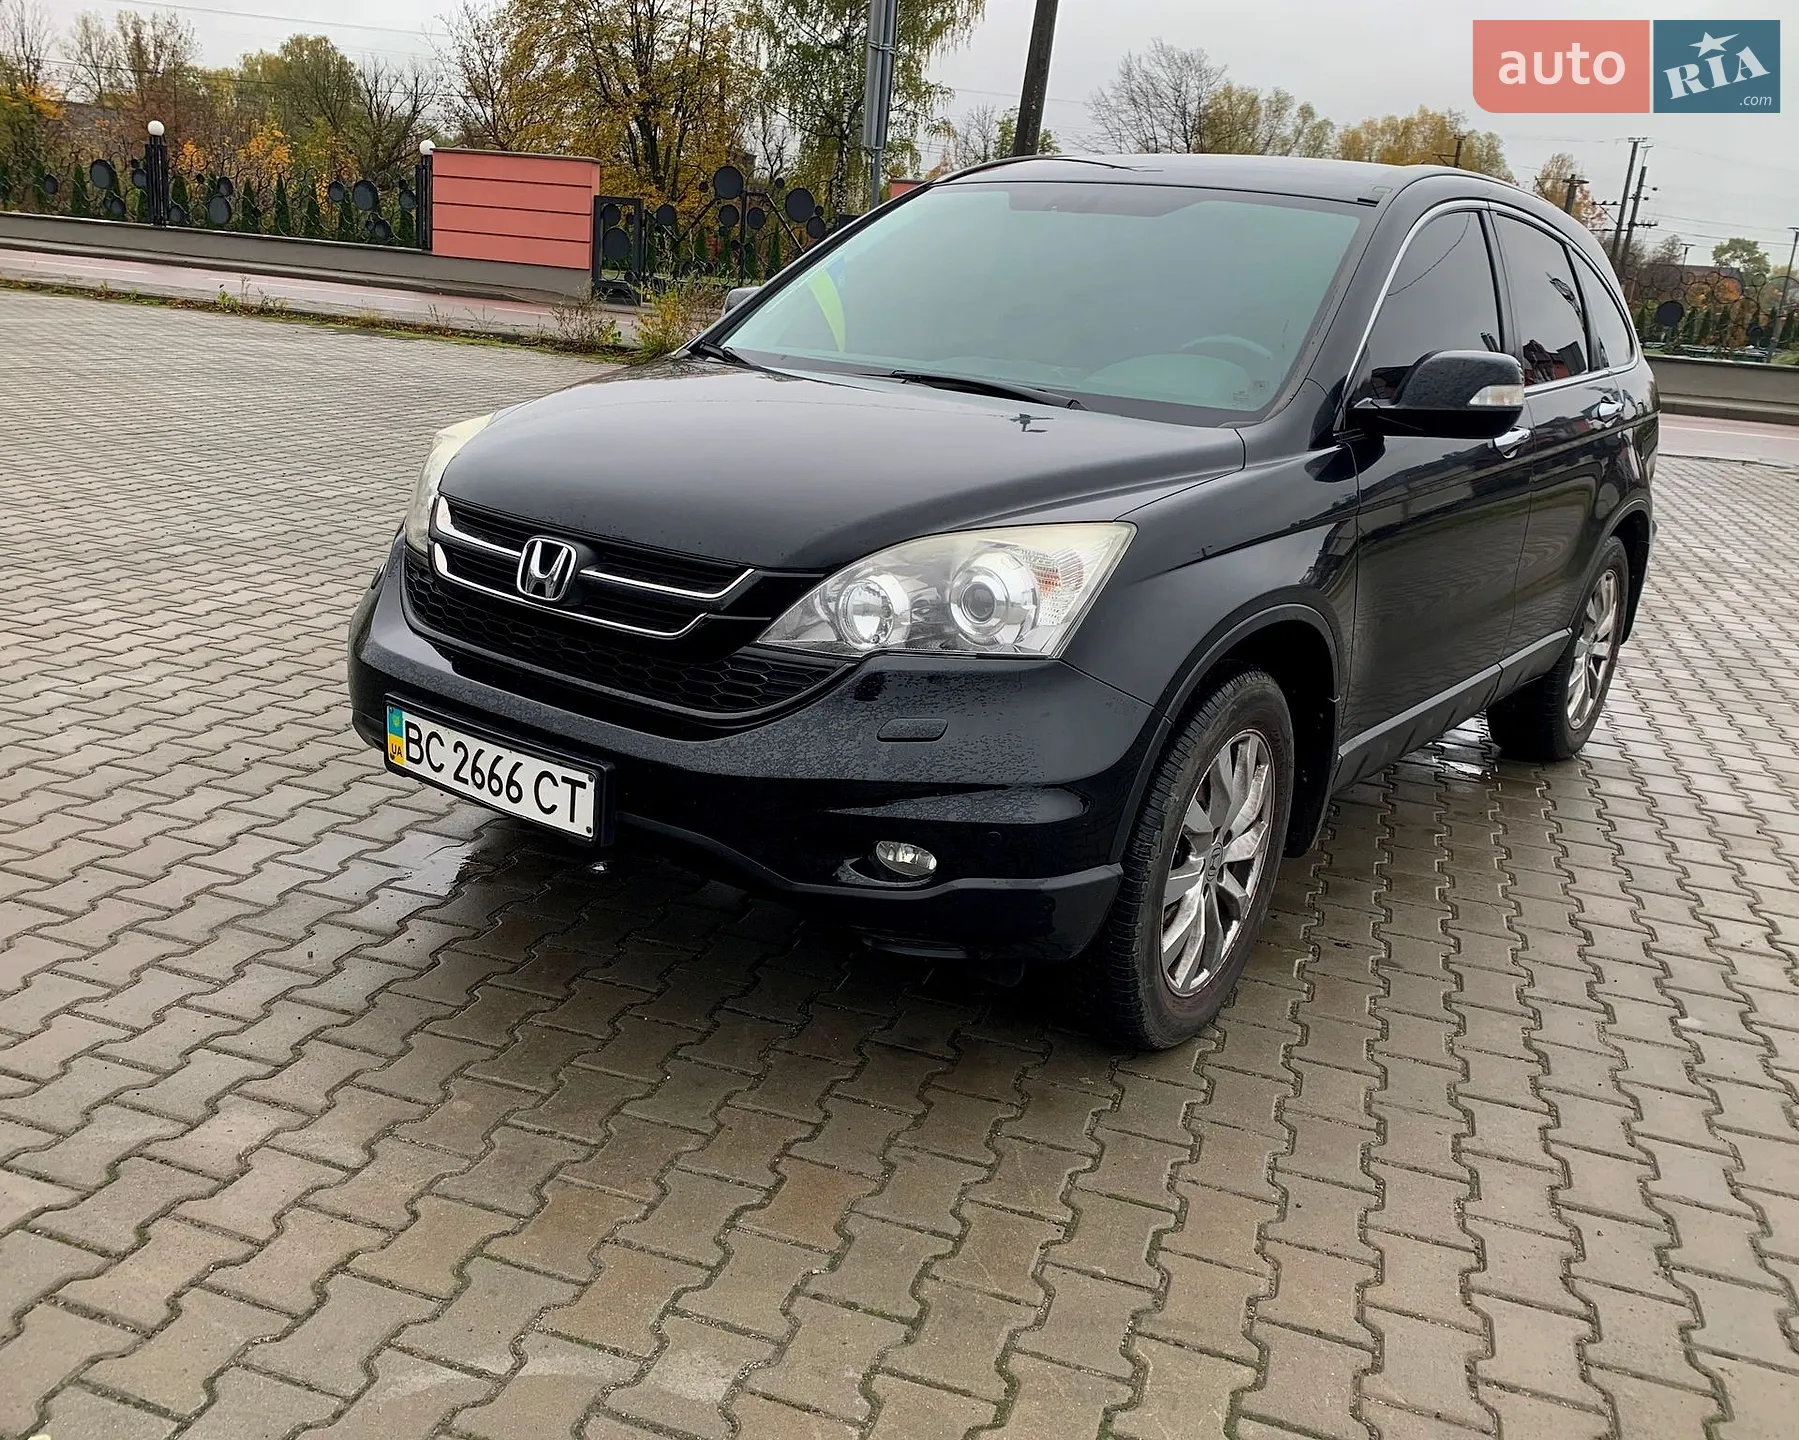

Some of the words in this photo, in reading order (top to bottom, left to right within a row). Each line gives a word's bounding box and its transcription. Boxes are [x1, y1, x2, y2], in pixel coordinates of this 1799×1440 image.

[391, 743, 403, 758] UA
[405, 720, 445, 773] BC
[453, 740, 524, 804] 2666
[534, 770, 587, 823] CT
